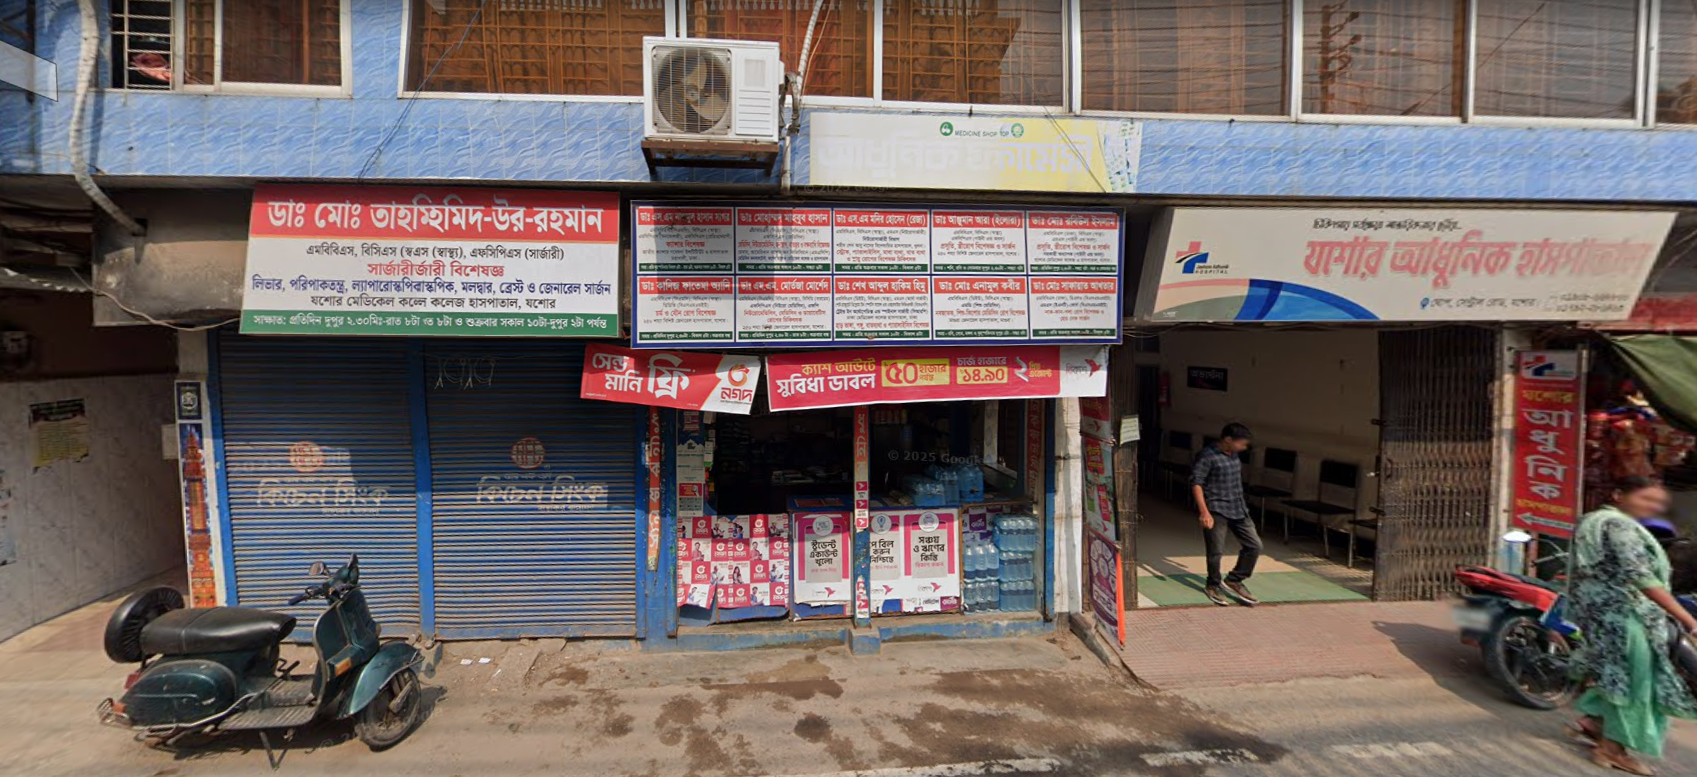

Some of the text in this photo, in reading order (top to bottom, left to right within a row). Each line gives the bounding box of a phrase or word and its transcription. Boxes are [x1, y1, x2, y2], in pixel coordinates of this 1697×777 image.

[267, 199, 306, 228] ডাঃ
[314, 200, 361, 229] মোঃ
[740, 213, 752, 221] ডাঃ
[836, 215, 846, 223] ডাঃ
[935, 216, 946, 224] ডাঃ
[1032, 217, 1045, 225] ডাঃ
[1047, 217, 1063, 226] মোঃ
[306, 242, 358, 257] এমবিবিএস,
[361, 243, 397, 257] বিসিএস
[470, 244, 521, 260] এফসিপিএস
[1390, 229, 1517, 289] আধুনিক
[450, 260, 505, 277] বিশেষজ্ঞ
[252, 274, 286, 292] লিভার,
[527, 284, 536, 293] ও
[539, 281, 581, 295] জেনারেল
[584, 280, 611, 295] সার্জন
[642, 281, 654, 290] ডাঃ
[741, 282, 751, 290] ডাঃ
[838, 282, 850, 290] ডাঃ
[939, 282, 952, 290] ডাঃ
[955, 282, 970, 290] মোঃ
[1033, 282, 1044, 290] ডাঃ
[1046, 282, 1060, 290] মোঃ
[311, 296, 343, 307] যশোর
[347, 293, 394, 308] মেডিকেল
[430, 297, 464, 308] কলেজ
[469, 296, 521, 310] হাসপাতাল,
[526, 298, 556, 309] যশোর
[289, 312, 322, 326] প্রতিদিন
[454, 317, 463, 327] ও
[500, 317, 525, 328] সকাল
[592, 352, 630, 372] সেন্ড
[802, 358, 876, 375] ক্যাশ আউটে
[1014, 356, 1030, 383] ২
[605, 369, 643, 393] মানি
[647, 353, 691, 399] ফ্রি
[776, 373, 876, 398] সুবিধা ডাবল
[720, 387, 753, 402] নগদ
[878, 538, 894, 548] বিল
[913, 545, 920, 553] ও
[815, 557, 832, 566] খুলো
